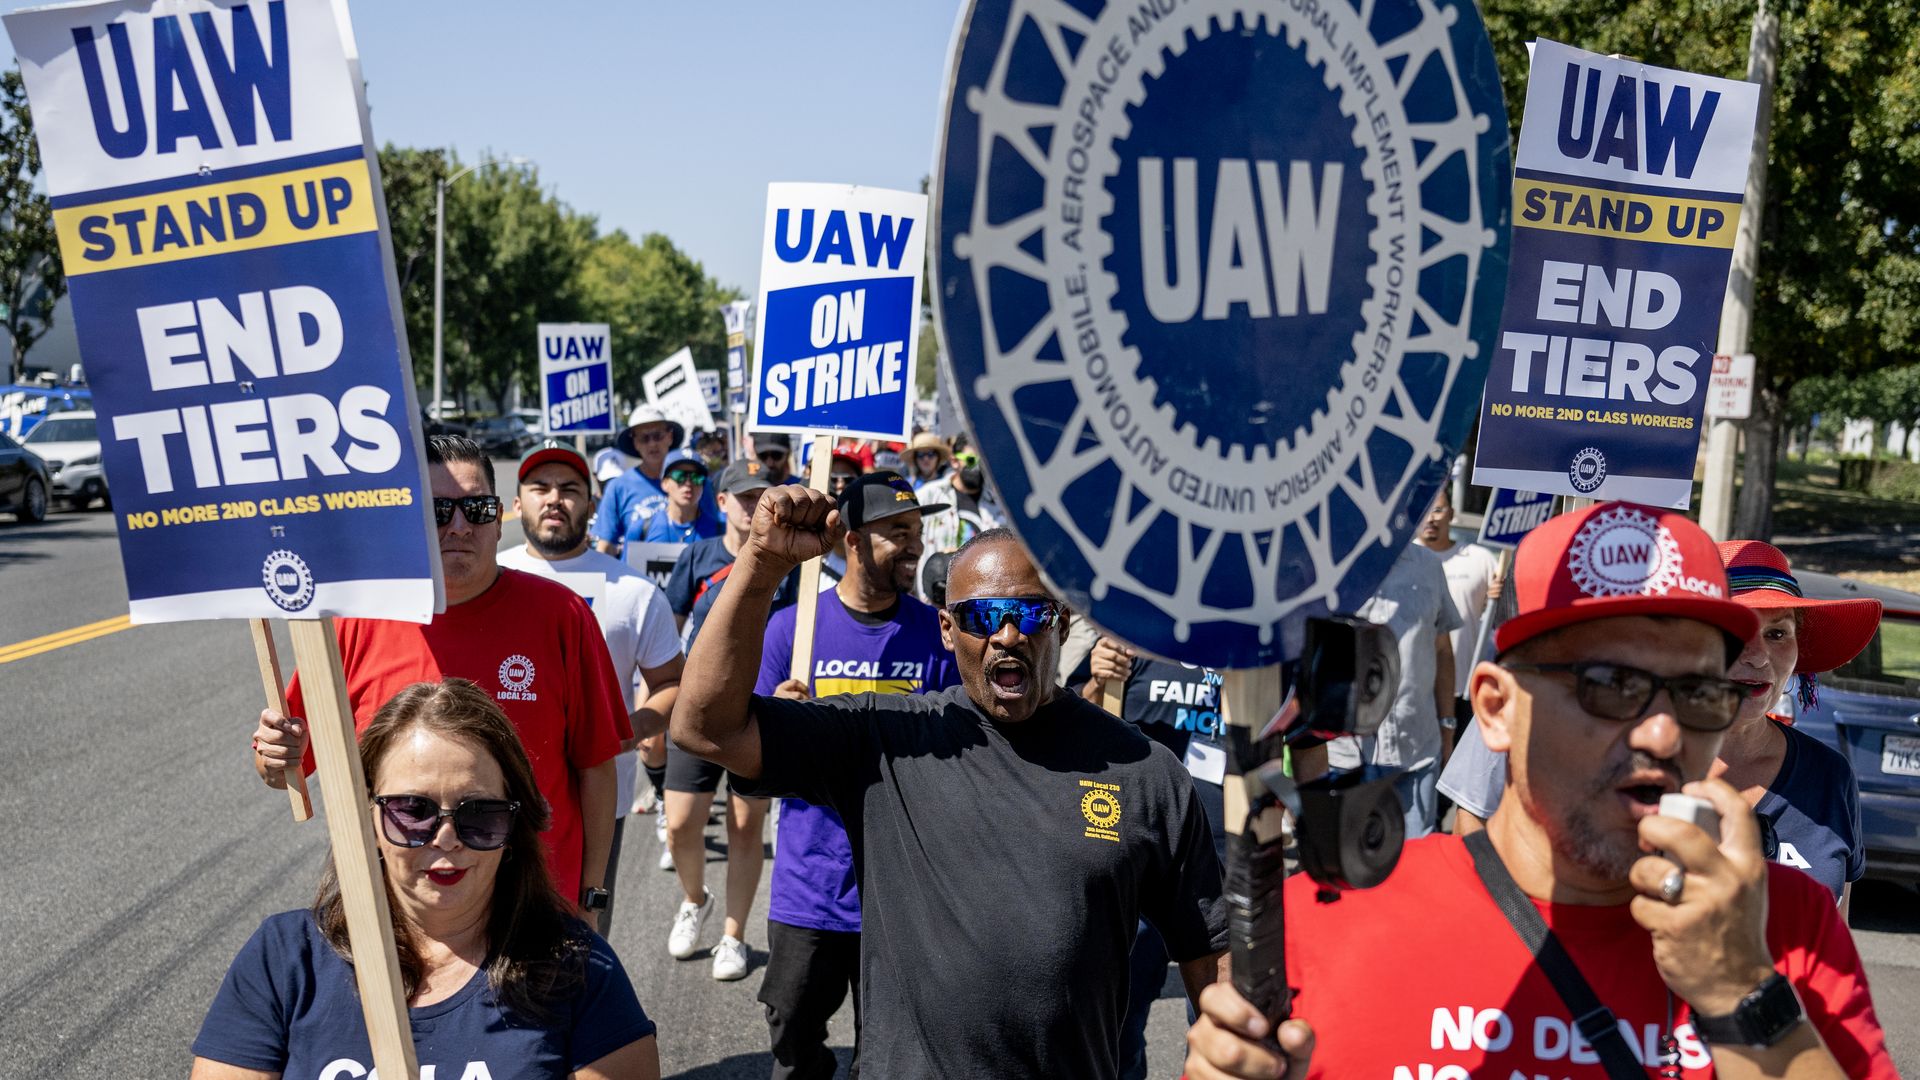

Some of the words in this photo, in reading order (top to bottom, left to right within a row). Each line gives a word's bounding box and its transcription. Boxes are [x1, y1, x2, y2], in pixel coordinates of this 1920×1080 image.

[71, 0, 292, 159] UAW
[1061, 34, 1131, 250] AEROSPACE
[1340, 41, 1405, 224] IMPLEMENT
[1557, 62, 1721, 179] UAW
[79, 192, 267, 261] STAND
[282, 176, 352, 231] UP
[1521, 188, 1653, 234] STAND
[1666, 205, 1725, 240] UP
[774, 208, 914, 271] UAW
[1137, 157, 1345, 324] UAW
[810, 288, 866, 350] ON
[1362, 234, 1405, 393] WORKERS
[1536, 260, 1682, 330] END
[137, 286, 344, 392] END
[545, 336, 604, 360] UAW
[565, 368, 590, 399] ON
[764, 340, 903, 418] STRIKE
[1064, 263, 1169, 476] AUTOMOBILE,
[1501, 332, 1701, 405] TIERS
[550, 389, 608, 430] STRIKE
[1345, 396, 1366, 437] OF
[1491, 403, 1513, 416] NO
[1514, 405, 1554, 420] MORE
[1556, 408, 1584, 421] 2ND
[1586, 410, 1628, 425] CLASS
[1631, 413, 1694, 430] WORKERS
[113, 385, 402, 494] TIERS
[1168, 466, 1255, 514] UNITED
[1265, 430, 1343, 508] AMERICA
[1580, 463, 1596, 475] UAW
[127, 512, 158, 530] NO
[161, 506, 219, 526] MORE
[222, 501, 257, 520] 2ND
[260, 496, 320, 517] CLASS
[323, 488, 413, 510] WORKERS
[1487, 501, 1551, 537] STRIKE
[276, 572, 298, 586] UAW
[1601, 544, 1650, 566] UAW
[508, 668, 525, 678] UAW
[815, 660, 884, 678] LOCAL
[890, 661, 923, 678] 721
[497, 691, 520, 700] LOCAL
[521, 692, 537, 701] 230
[1149, 680, 1216, 707] FAIR
[1175, 708, 1226, 736] NO
[1092, 802, 1110, 813] UAW
[1430, 1005, 1513, 1052] NO
